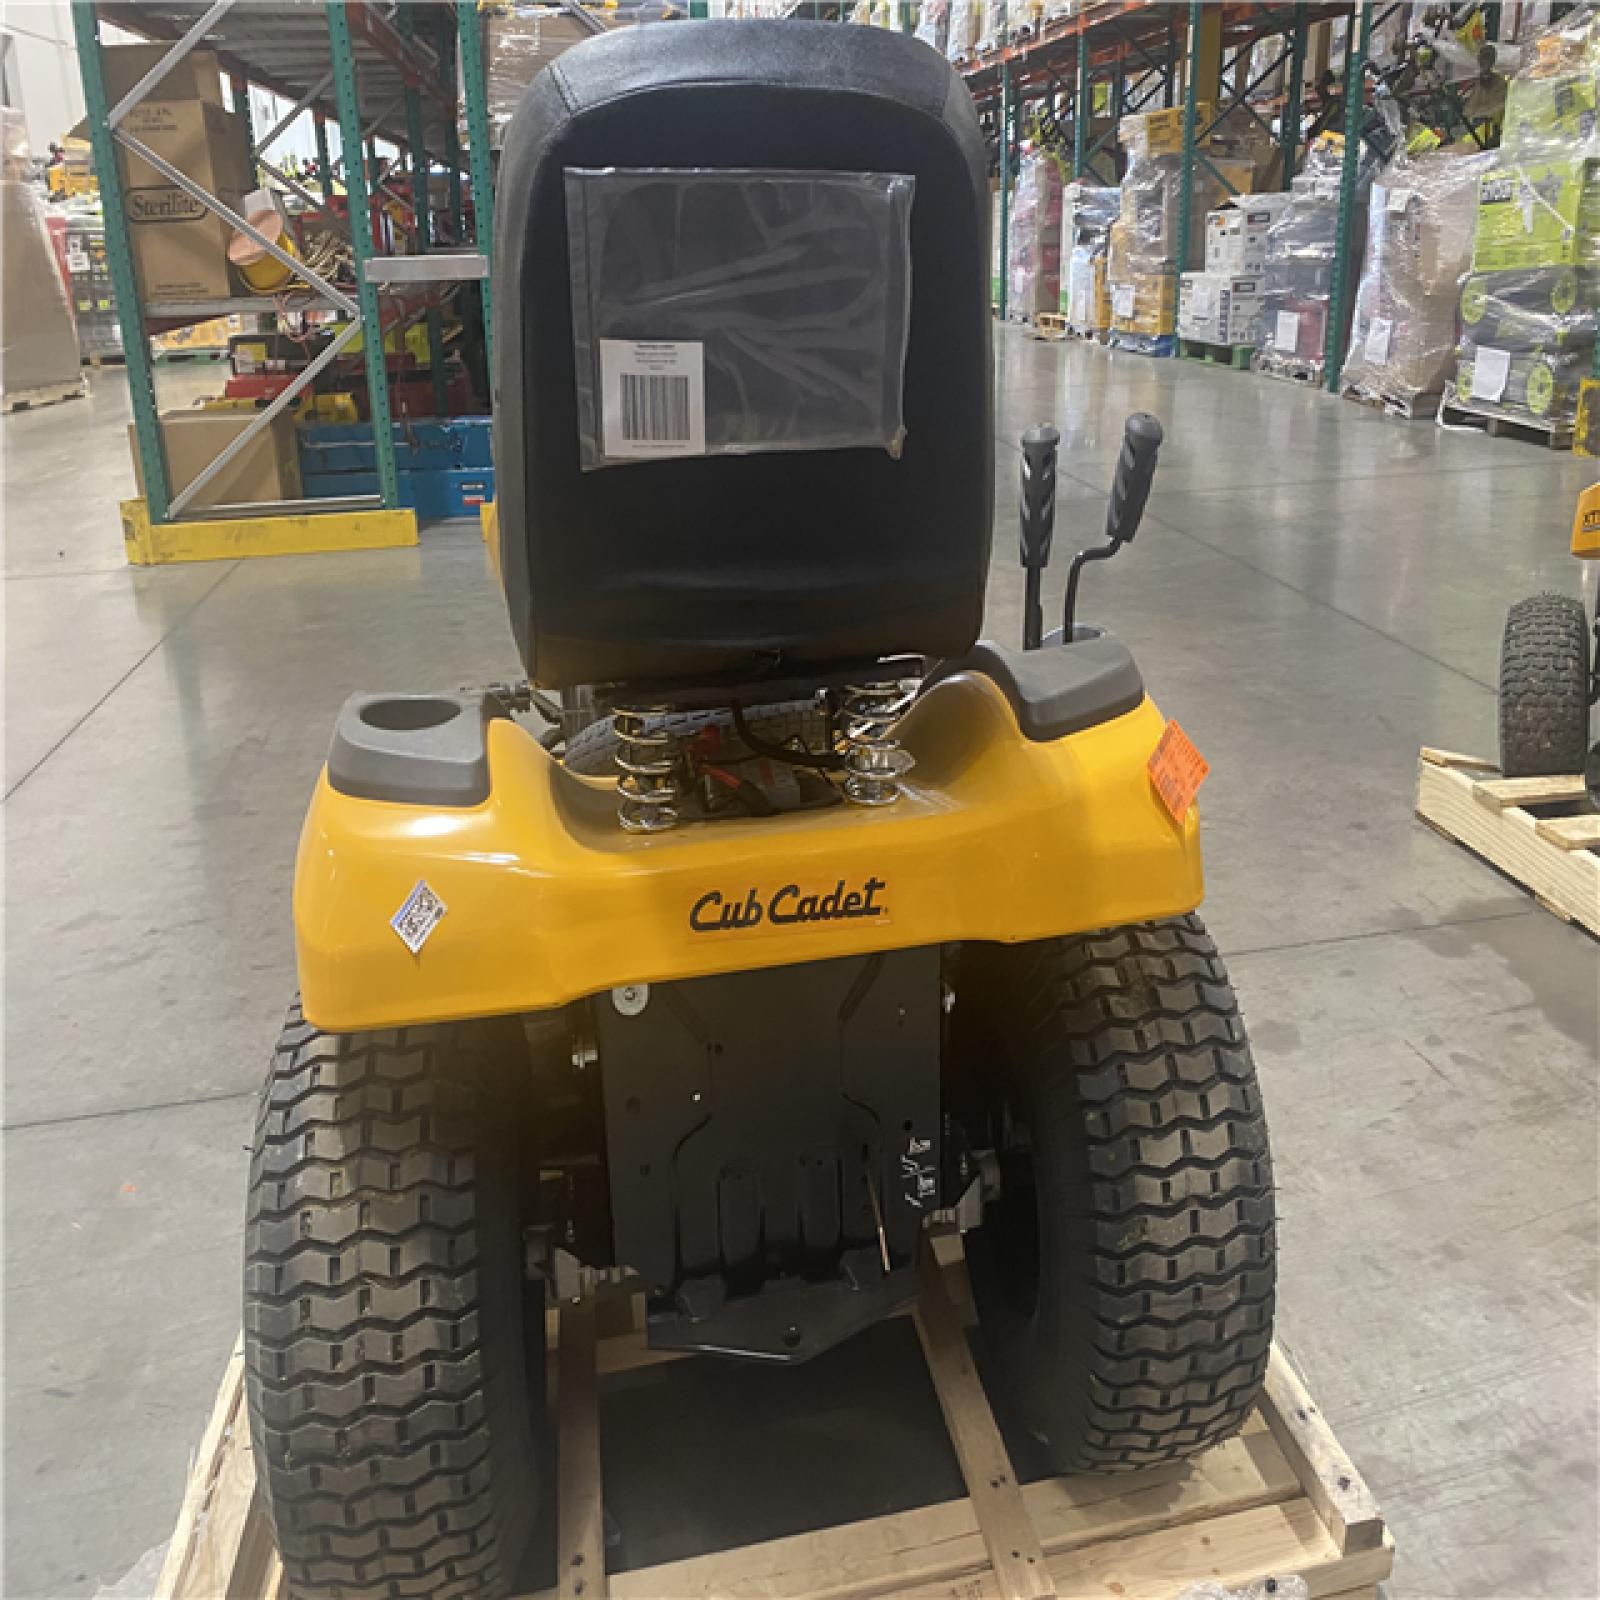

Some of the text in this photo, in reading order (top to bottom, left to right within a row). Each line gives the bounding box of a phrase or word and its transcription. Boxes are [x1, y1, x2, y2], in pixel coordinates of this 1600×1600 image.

[132, 191, 201, 217] Sterilite
[689, 876, 886, 932] Cub Cadet
